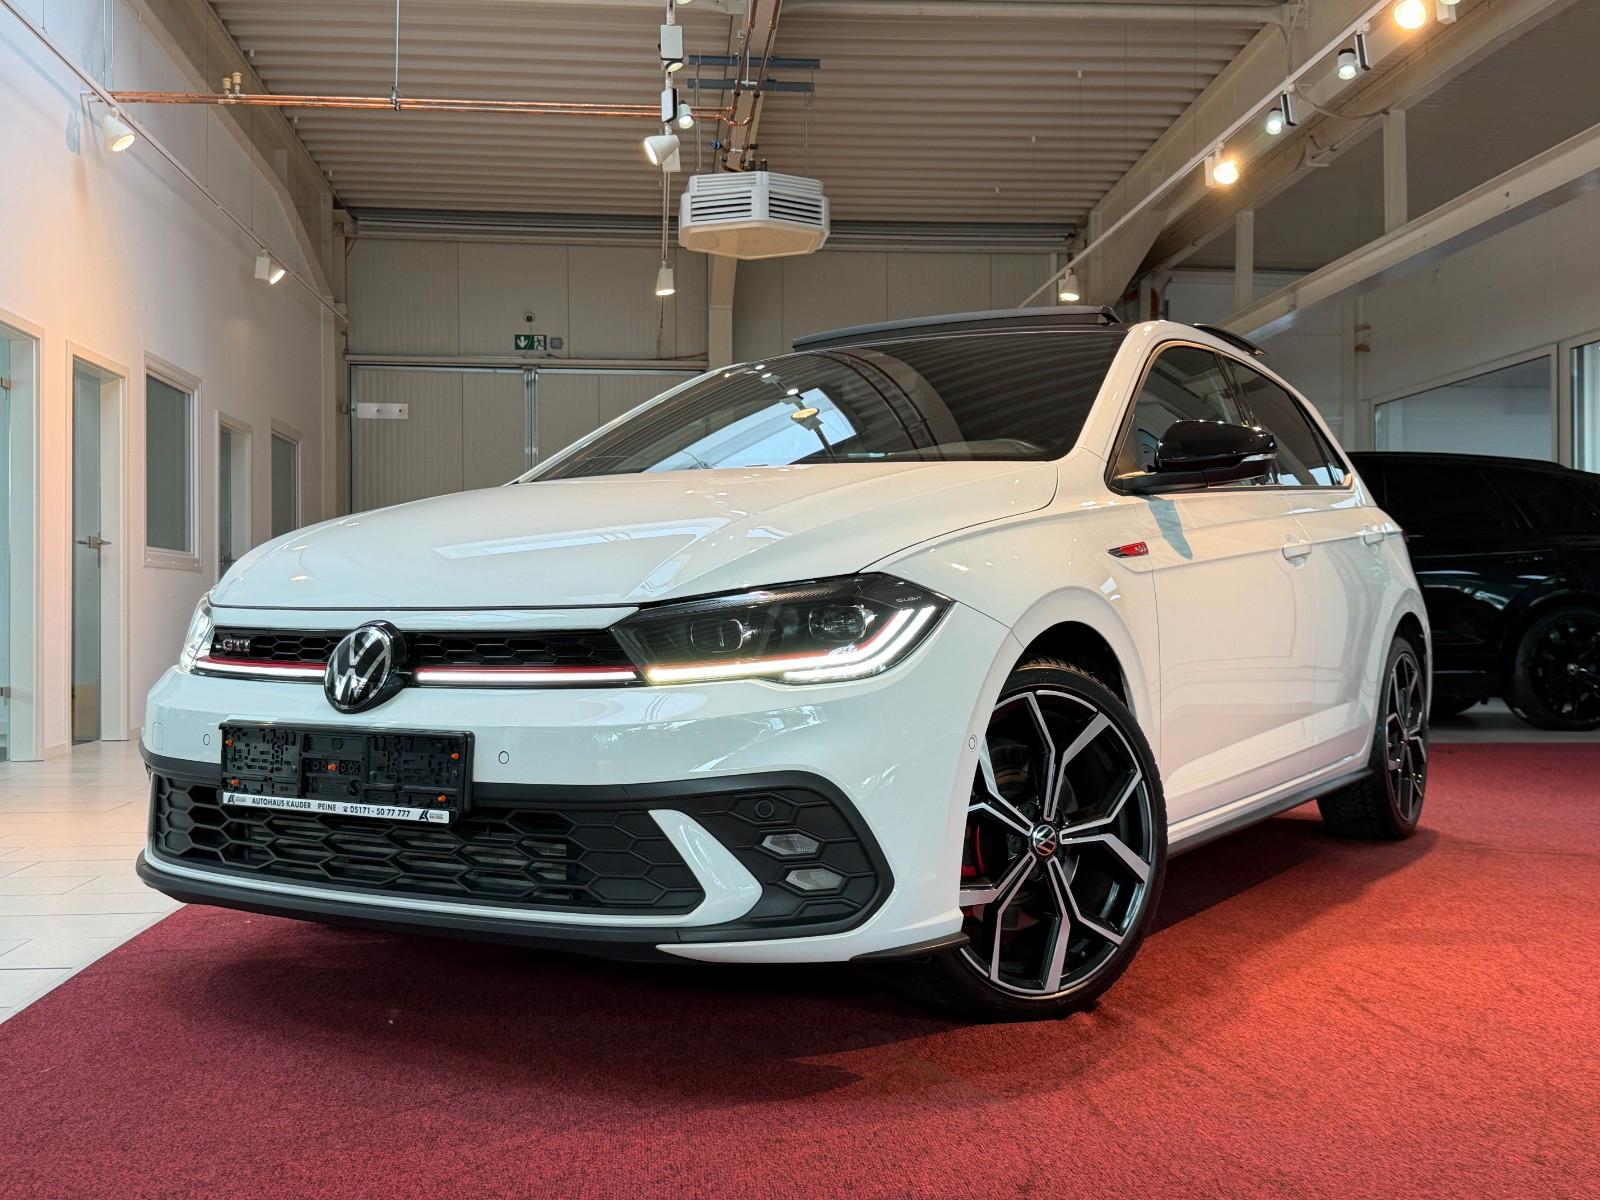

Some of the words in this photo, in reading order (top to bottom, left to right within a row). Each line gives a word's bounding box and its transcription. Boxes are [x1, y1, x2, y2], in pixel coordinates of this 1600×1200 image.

[251, 797, 285, 807] AUTOHAUS
[286, 800, 312, 809] KAUDER
[317, 803, 337, 812] PEINE
[349, 805, 370, 814] 05171
[376, 808, 385, 816] 50
[386, 808, 396, 816] 77
[397, 809, 411, 817] 777
